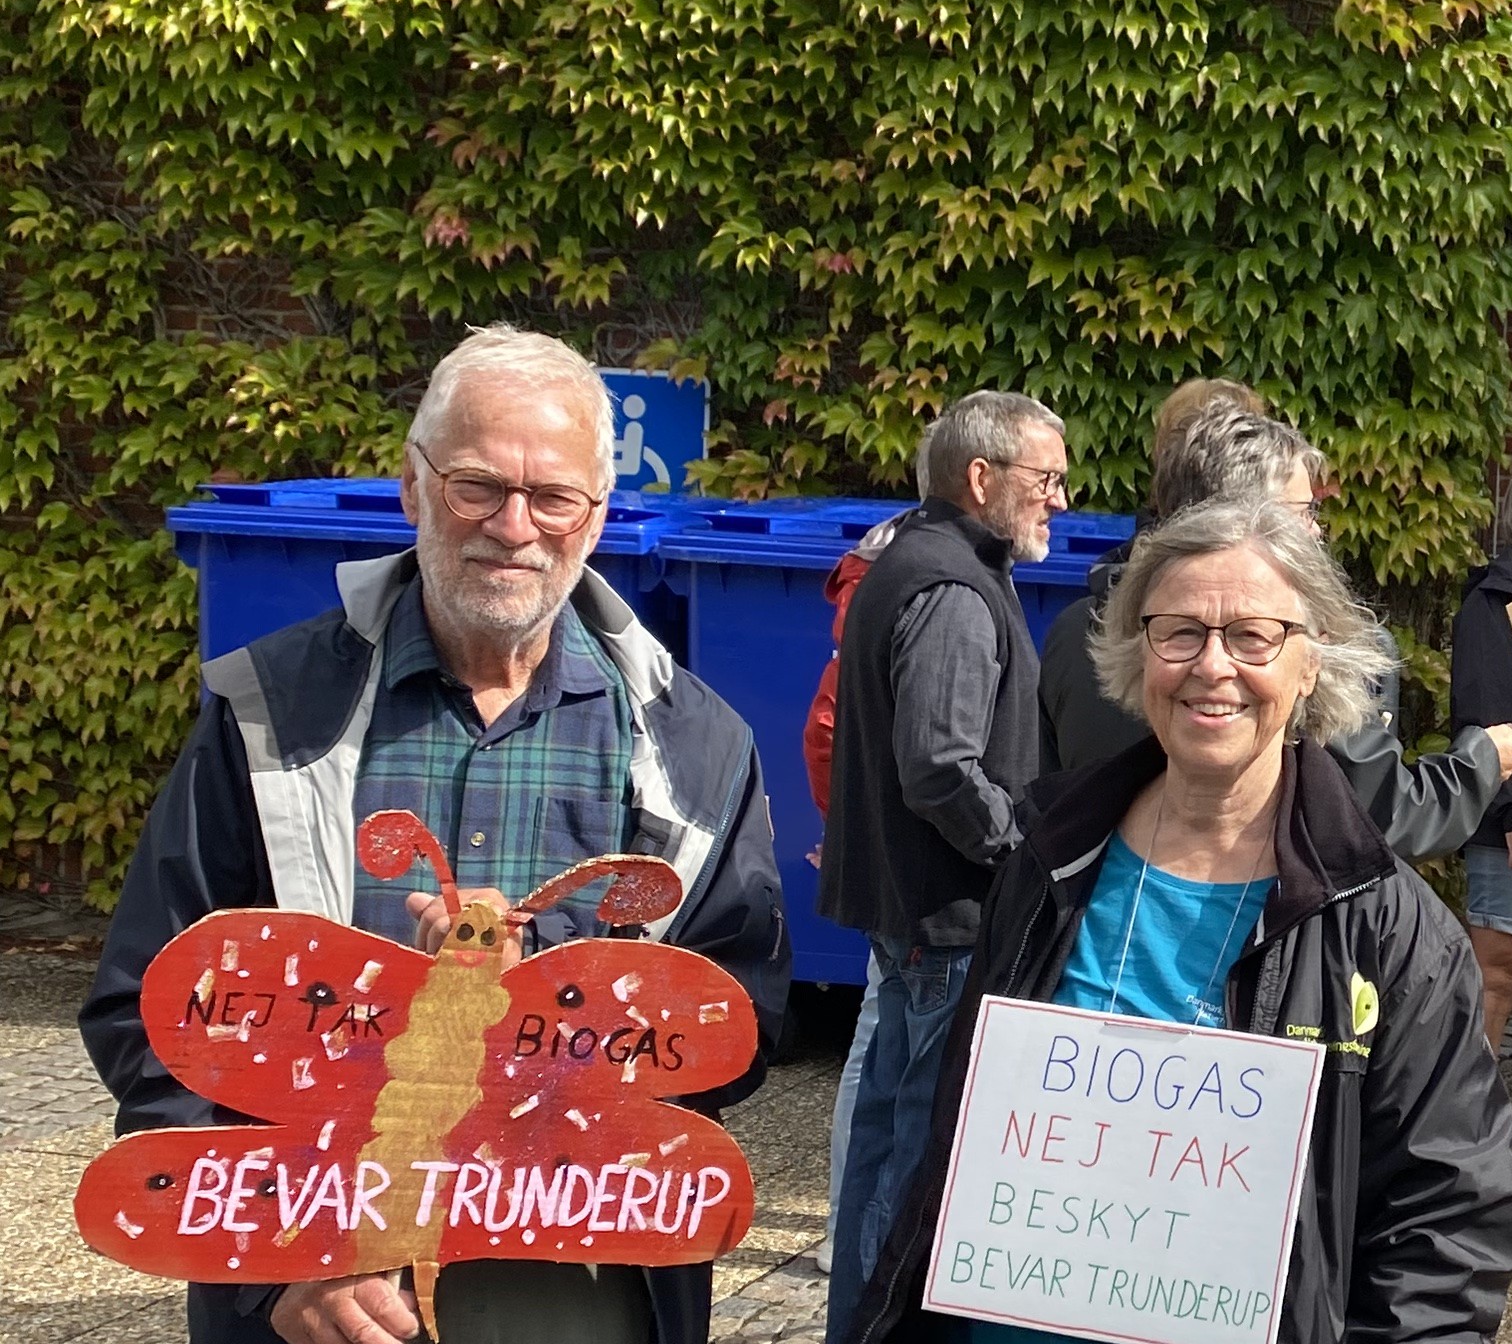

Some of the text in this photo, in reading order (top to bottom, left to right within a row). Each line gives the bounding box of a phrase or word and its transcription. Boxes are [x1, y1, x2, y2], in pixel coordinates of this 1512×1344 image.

[185, 991, 390, 1039] NEJ TAK
[1042, 1035, 1265, 1118] BIOGAS
[1001, 1109, 1251, 1193] NEJ TAK
[177, 1156, 732, 1240] BEVAR TRUNDERUP
[988, 1181, 1191, 1250] BESKYT
[949, 1240, 1272, 1330] BEVAR TRUNDERUP
